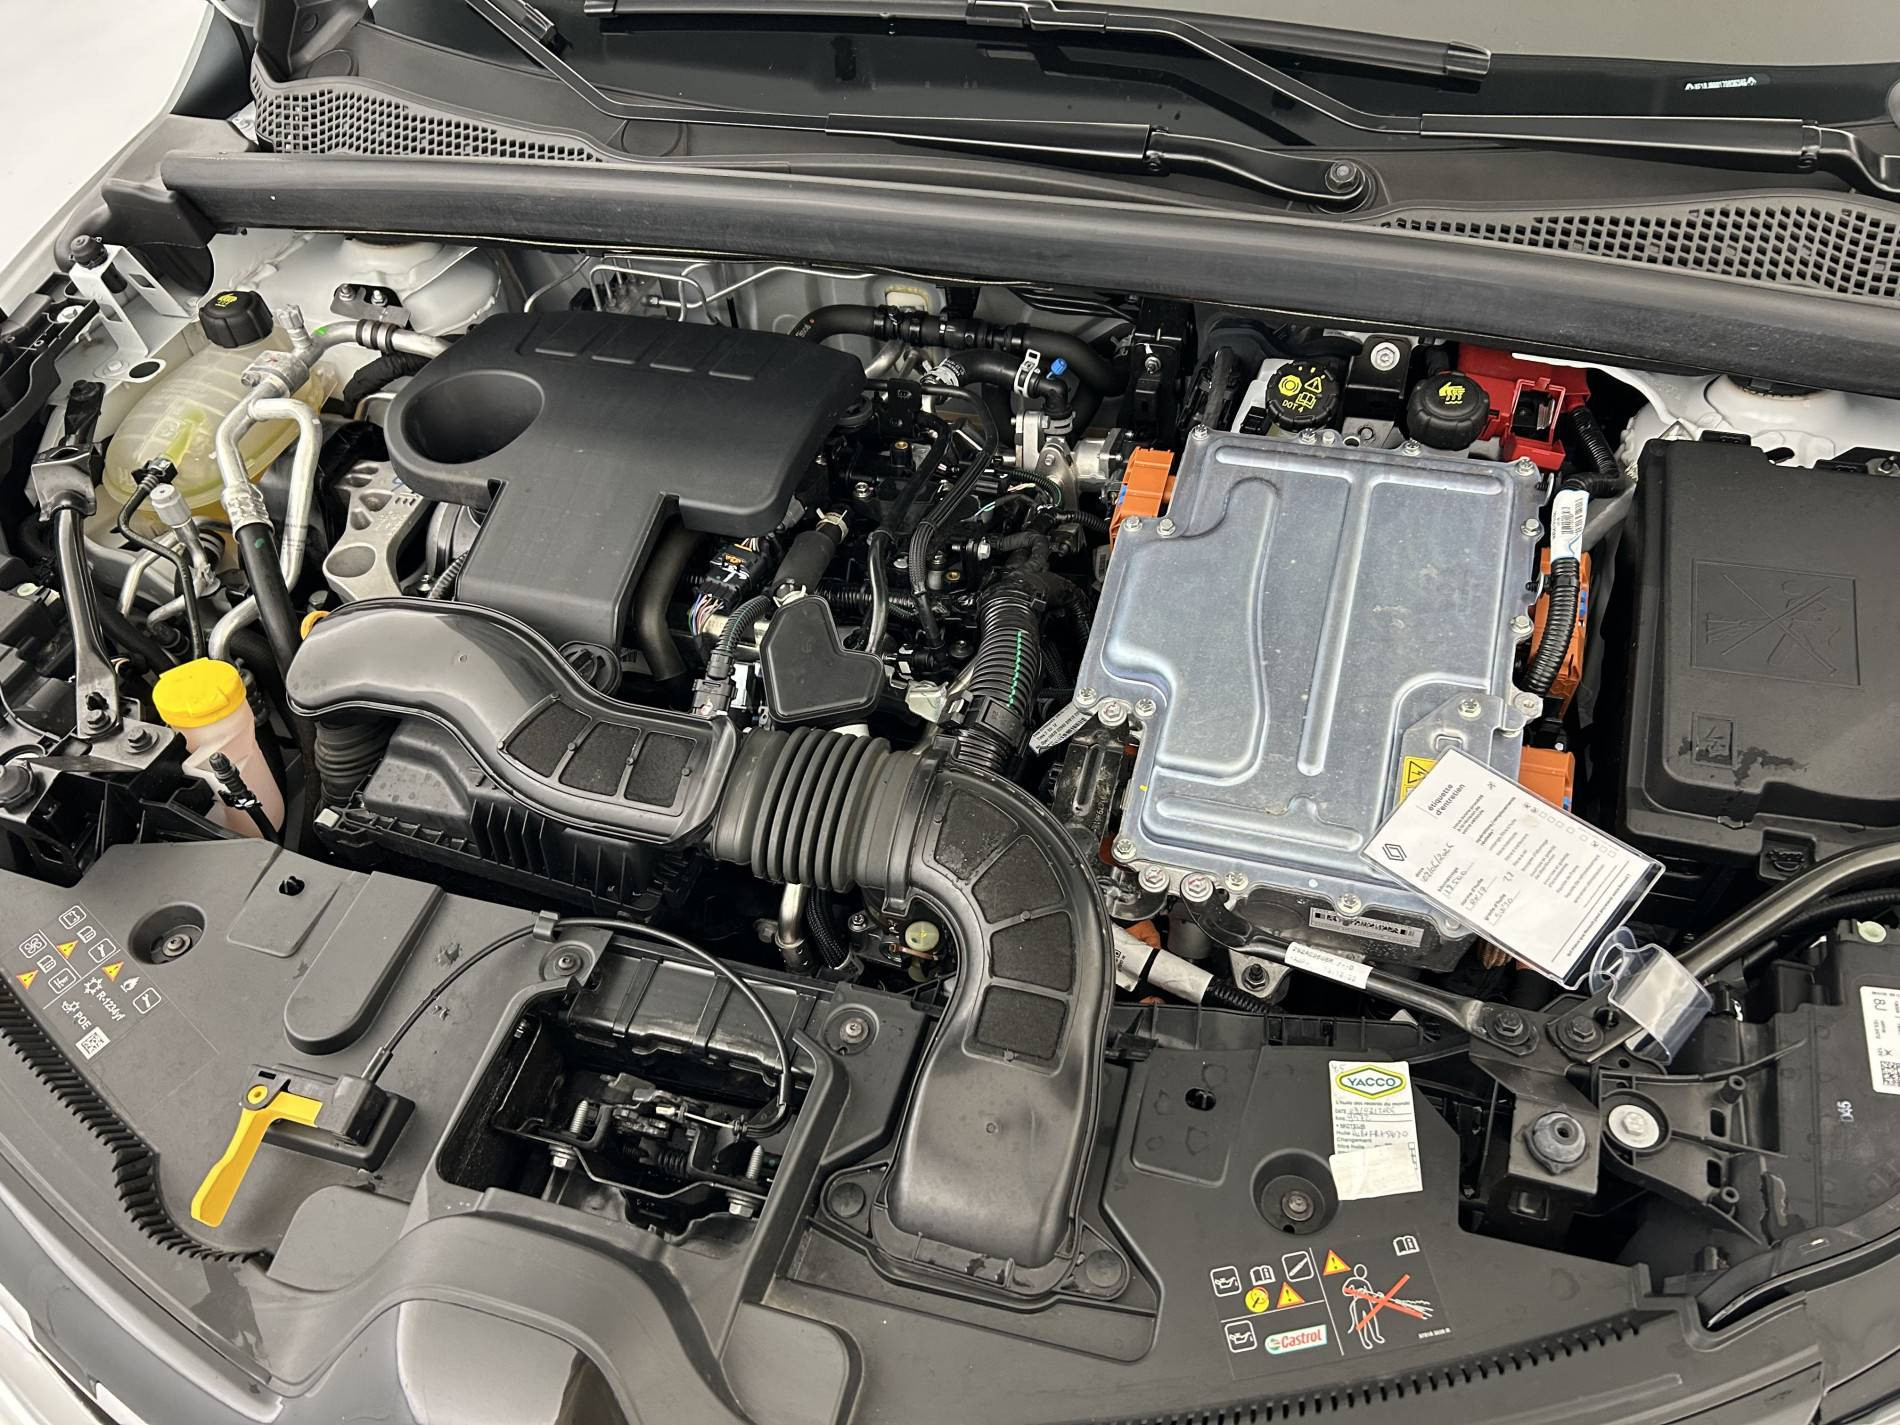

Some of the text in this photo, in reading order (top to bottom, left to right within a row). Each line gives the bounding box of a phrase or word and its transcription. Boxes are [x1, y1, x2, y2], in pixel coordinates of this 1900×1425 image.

[1282, 400, 1298, 410] DOT
[1428, 784, 1454, 812] étiquette
[1435, 784, 1465, 816] d'entretien
[74, 1010, 92, 1030] POE
[1347, 1078, 1396, 1087] YACCO
[1280, 1329, 1322, 1349] Castrol
